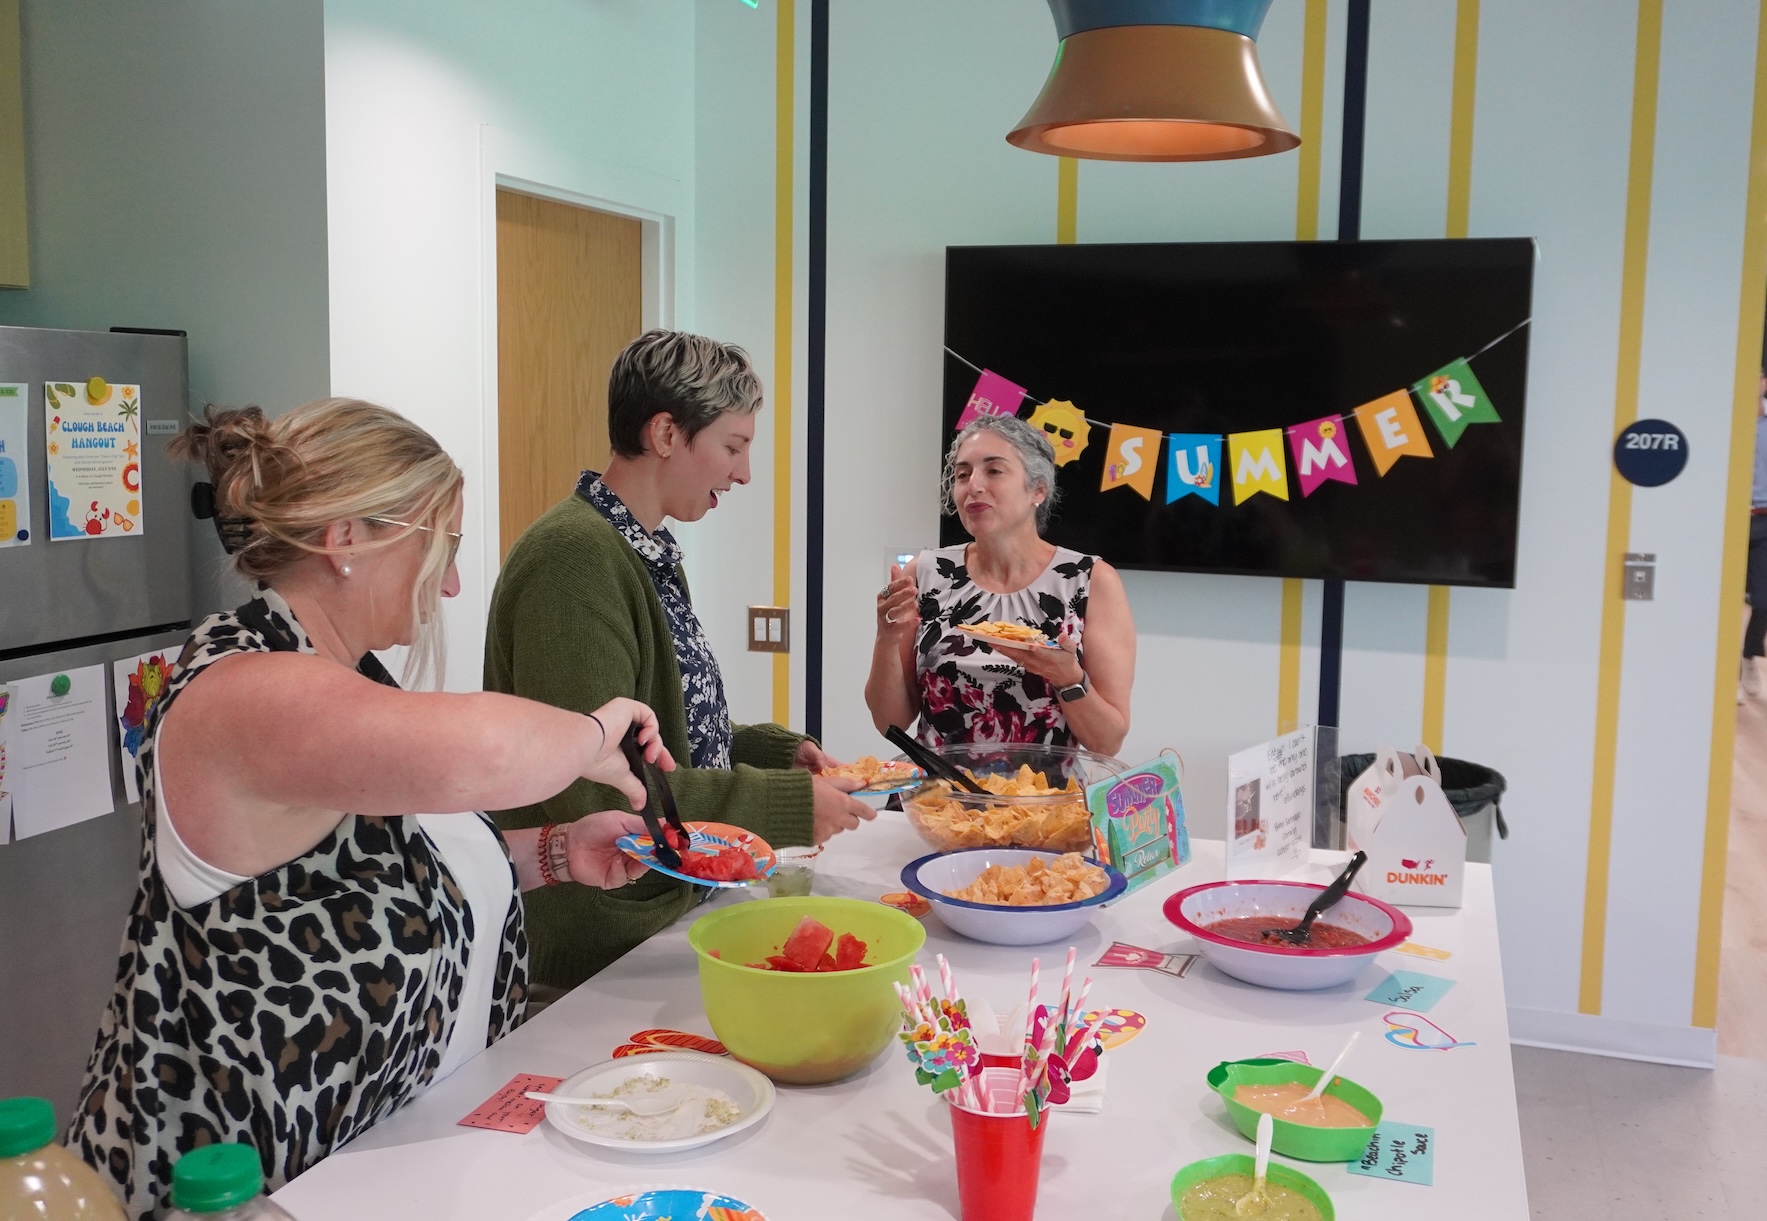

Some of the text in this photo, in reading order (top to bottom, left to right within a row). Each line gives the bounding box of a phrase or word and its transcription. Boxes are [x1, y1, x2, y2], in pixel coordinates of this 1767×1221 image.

[62, 421, 125, 433] CLOUGH BEACH
[1118, 378, 1477, 486] SUMMER
[1625, 432, 1680, 450] 207R
[71, 437, 116, 449] HANGOUT
[1109, 777, 1161, 815] SUMMER
[1122, 804, 1160, 845] Party
[1134, 849, 1160, 868] Relax
[1385, 1139, 1409, 1177] Chipotle
